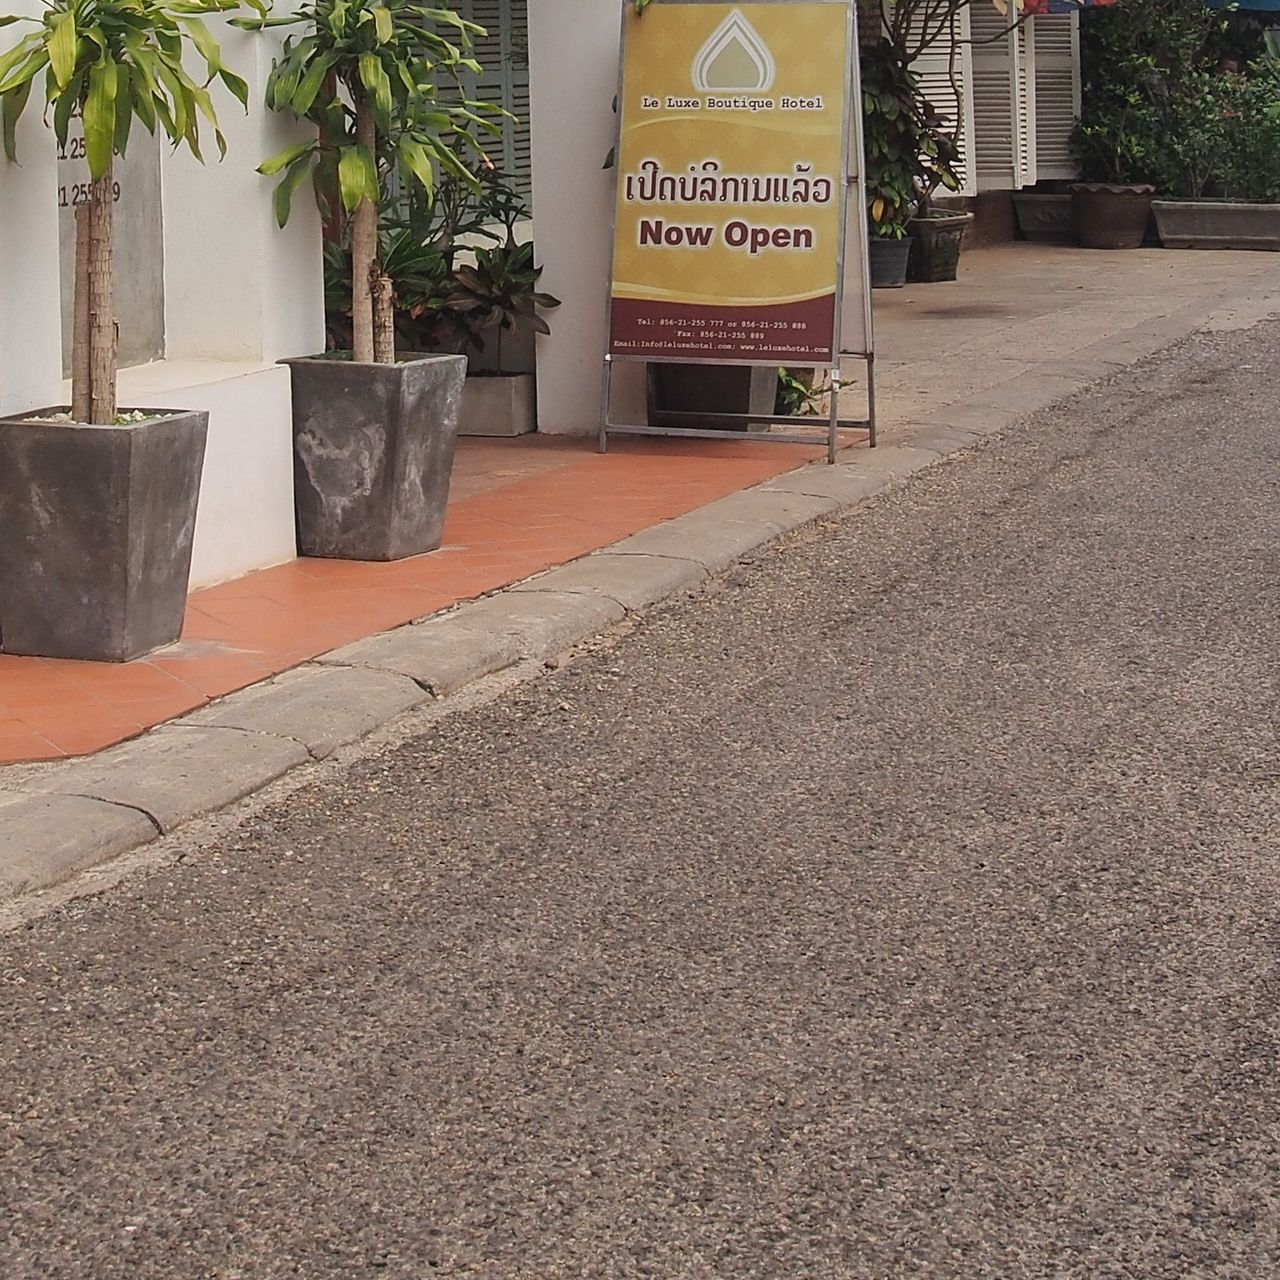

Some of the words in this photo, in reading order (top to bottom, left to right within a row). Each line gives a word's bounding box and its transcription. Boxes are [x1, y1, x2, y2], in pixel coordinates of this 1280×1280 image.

[643, 98, 659, 109] Le
[667, 98, 700, 109] Luxe
[707, 98, 773, 111] Boutique
[781, 98, 823, 109] Hotel
[640, 220, 713, 246] Now
[724, 221, 813, 253] Open
[637, 318, 655, 326] Tel:
